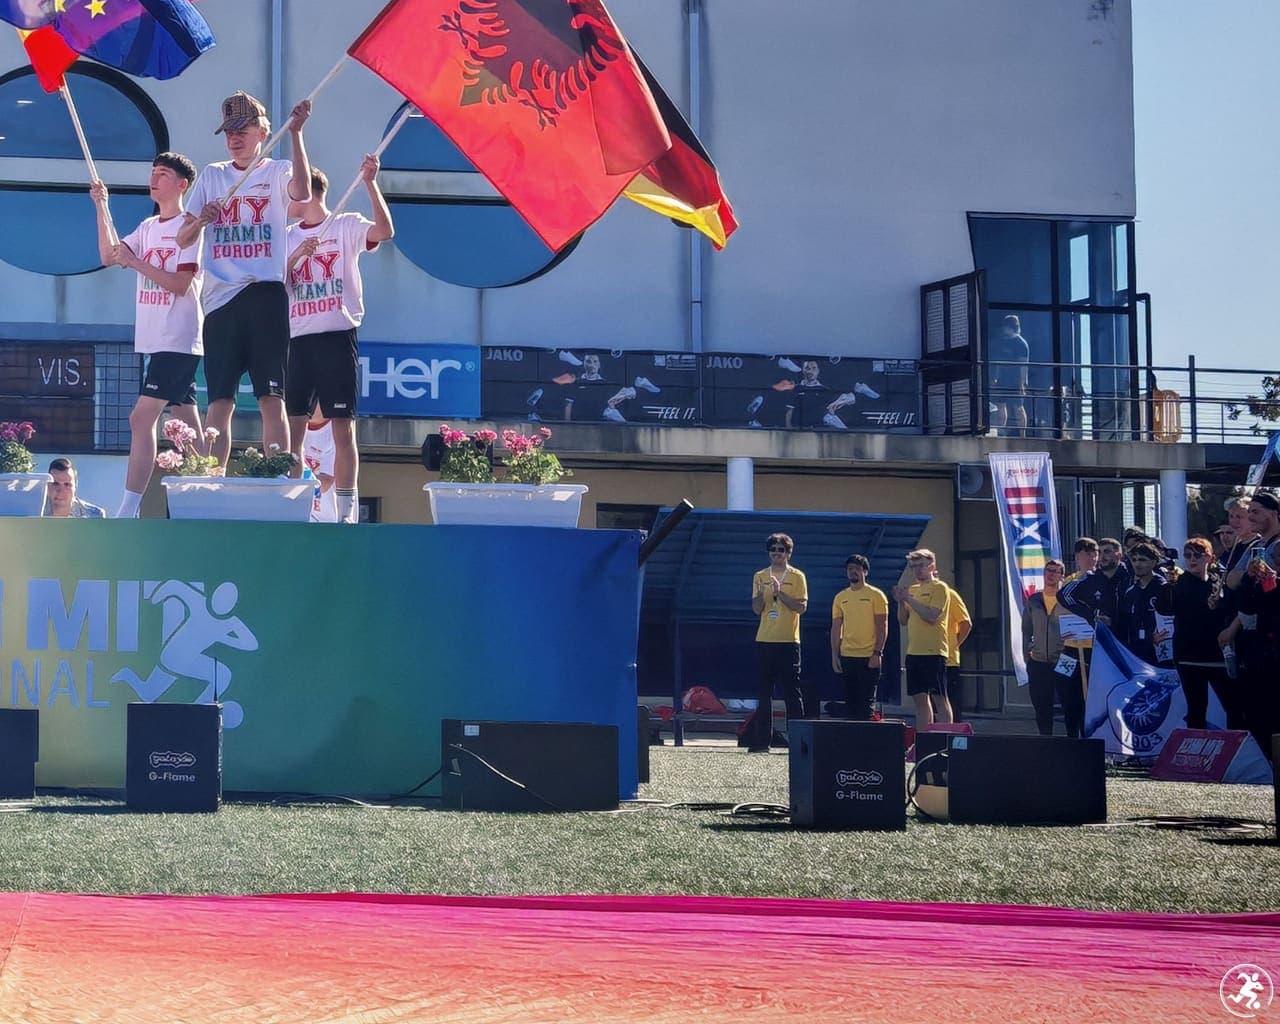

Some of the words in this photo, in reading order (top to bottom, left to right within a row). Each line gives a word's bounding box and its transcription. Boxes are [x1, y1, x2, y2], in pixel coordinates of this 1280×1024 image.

[216, 195, 271, 225] MY
[214, 225, 255, 244] TEAM
[259, 223, 272, 242] IS
[213, 242, 272, 260] EUROPE
[486, 348, 524, 362] JAKO
[706, 356, 743, 369] JAKO
[148, 771, 195, 782] G-Flame
[835, 790, 883, 801] G-Flame
